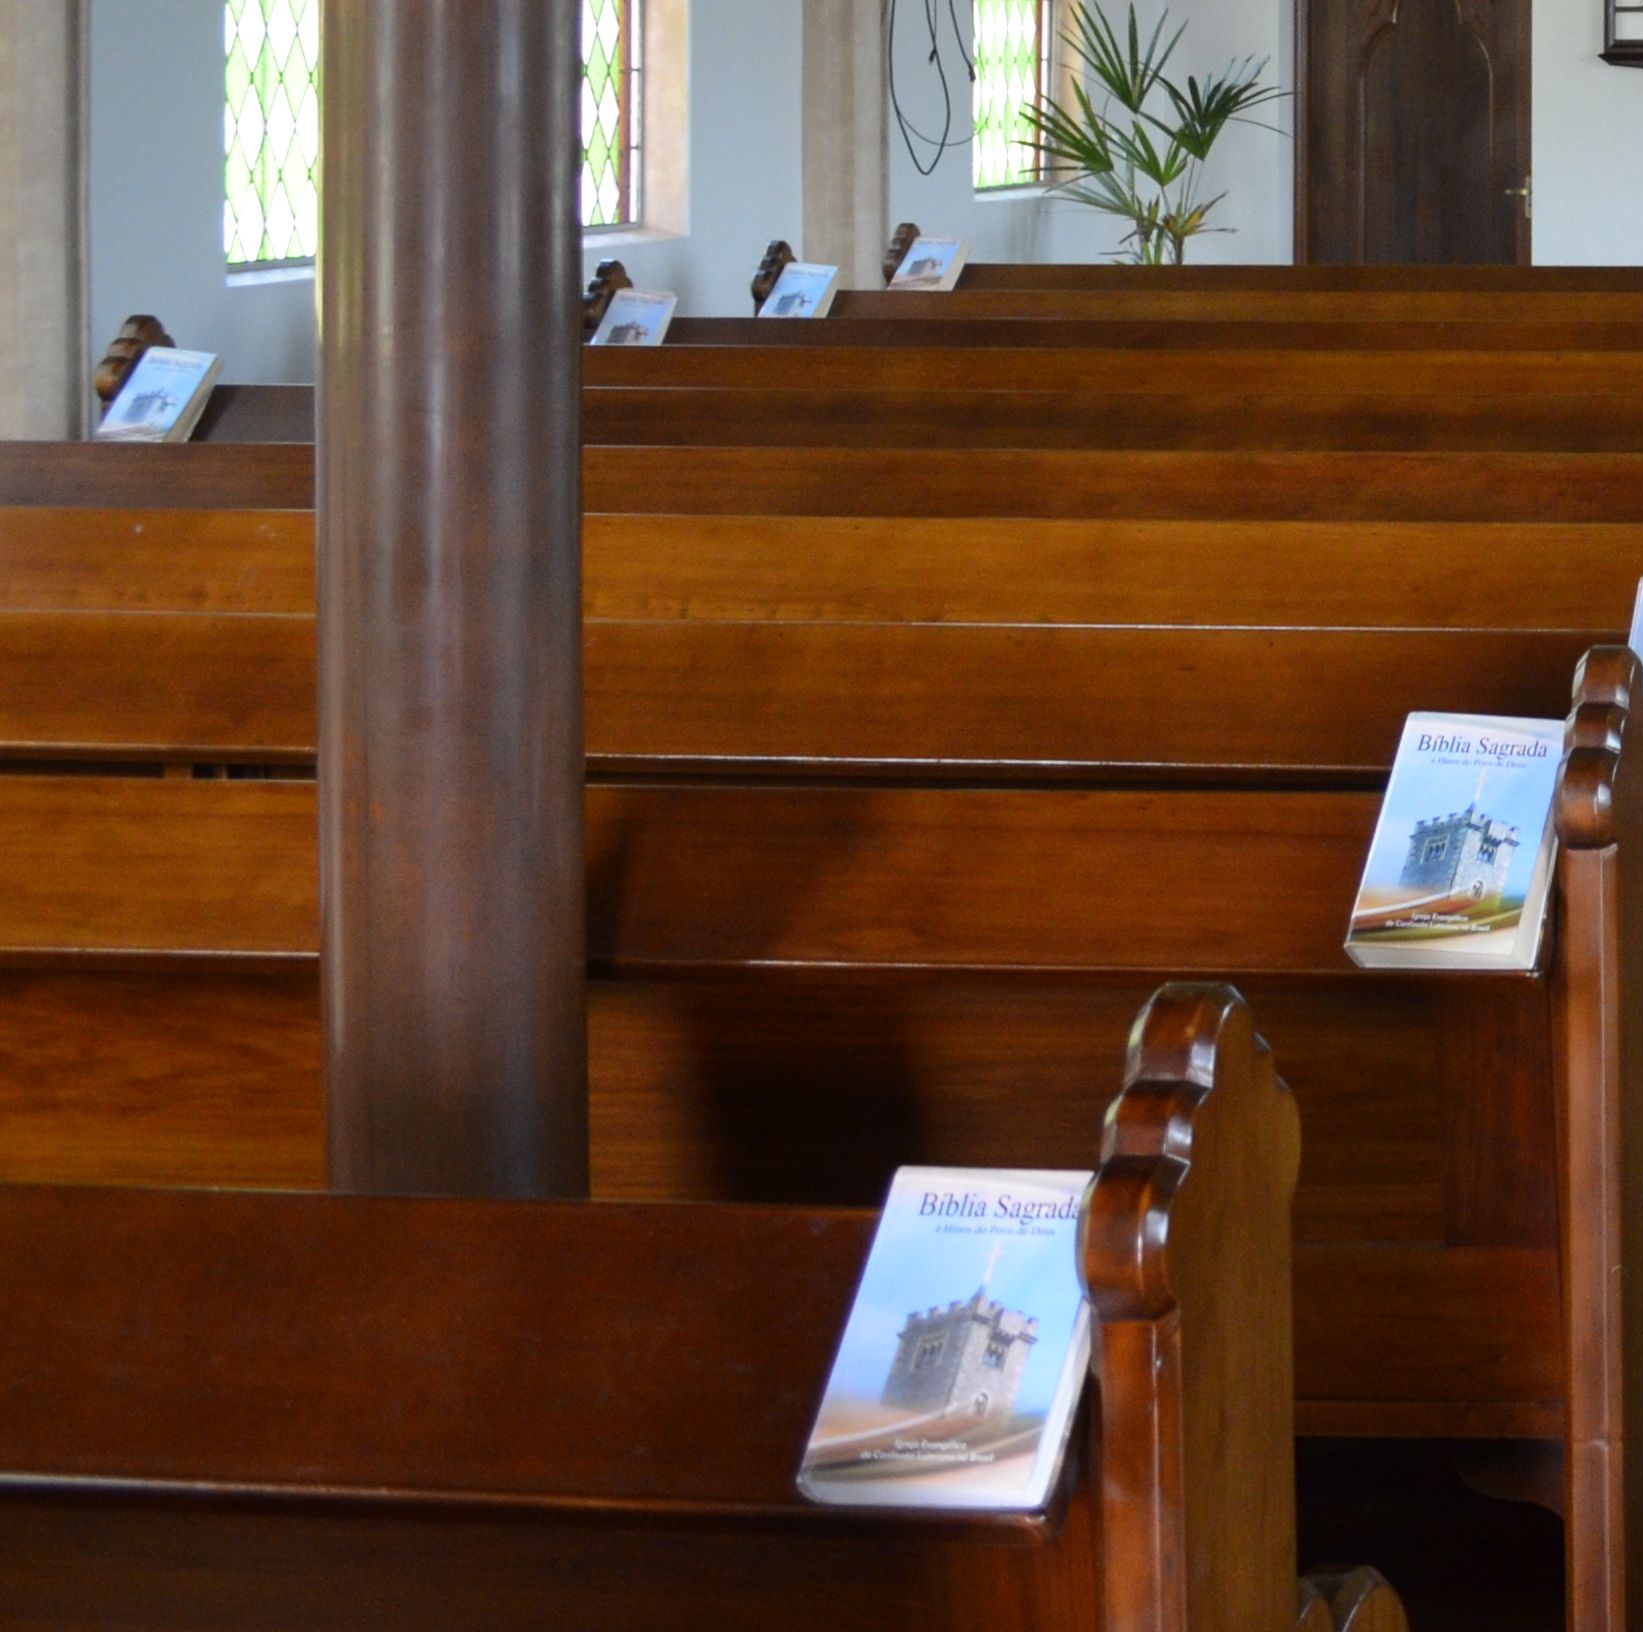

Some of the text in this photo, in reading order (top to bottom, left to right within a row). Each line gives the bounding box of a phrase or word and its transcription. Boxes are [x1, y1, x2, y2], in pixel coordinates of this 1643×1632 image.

[1476, 735, 1548, 761] Sagrada
[918, 1191, 1081, 1226] Bíblia Sagrada
